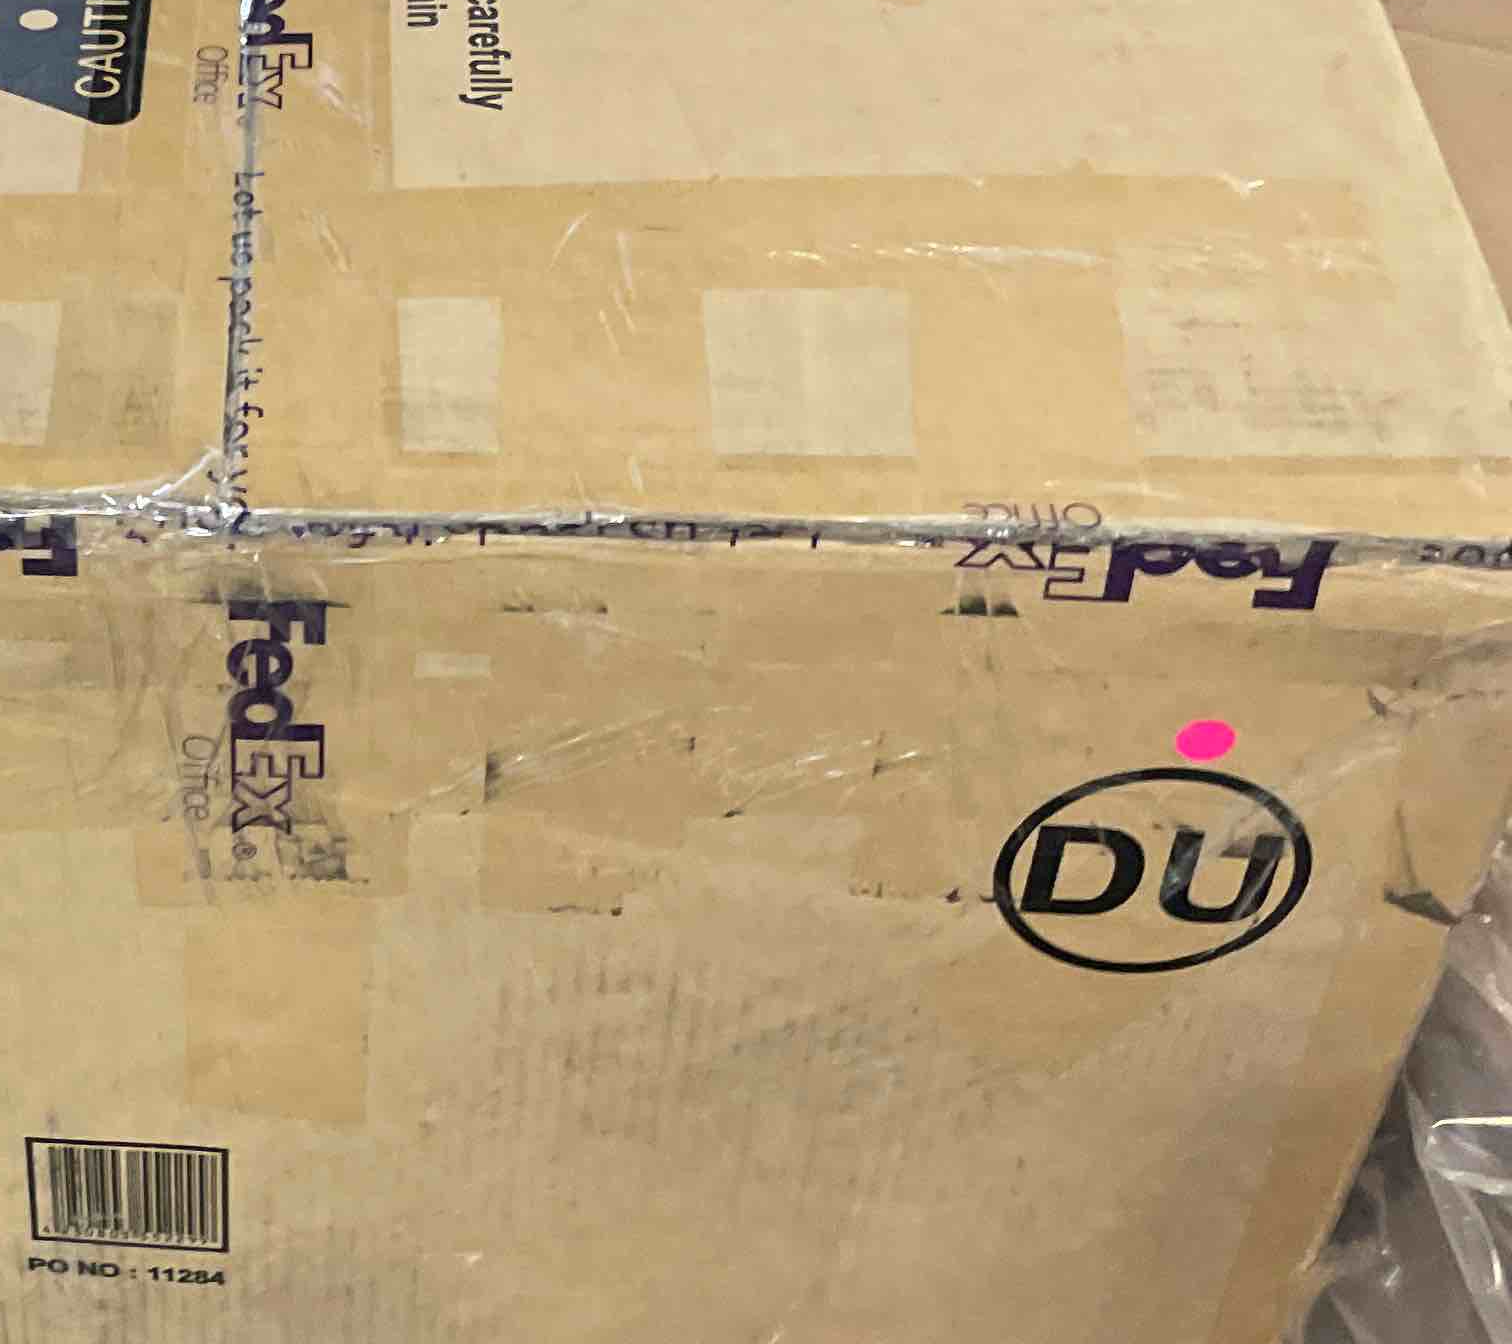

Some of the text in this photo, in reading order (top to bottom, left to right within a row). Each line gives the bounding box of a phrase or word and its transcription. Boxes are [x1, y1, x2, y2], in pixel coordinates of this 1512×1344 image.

[193, 44, 229, 103] Office
[226, 600, 328, 836] FedEx
[1019, 823, 1289, 924] DU
[28, 1256, 69, 1274] PO
[78, 1260, 121, 1279] NO
[148, 1265, 225, 1286] 11284
